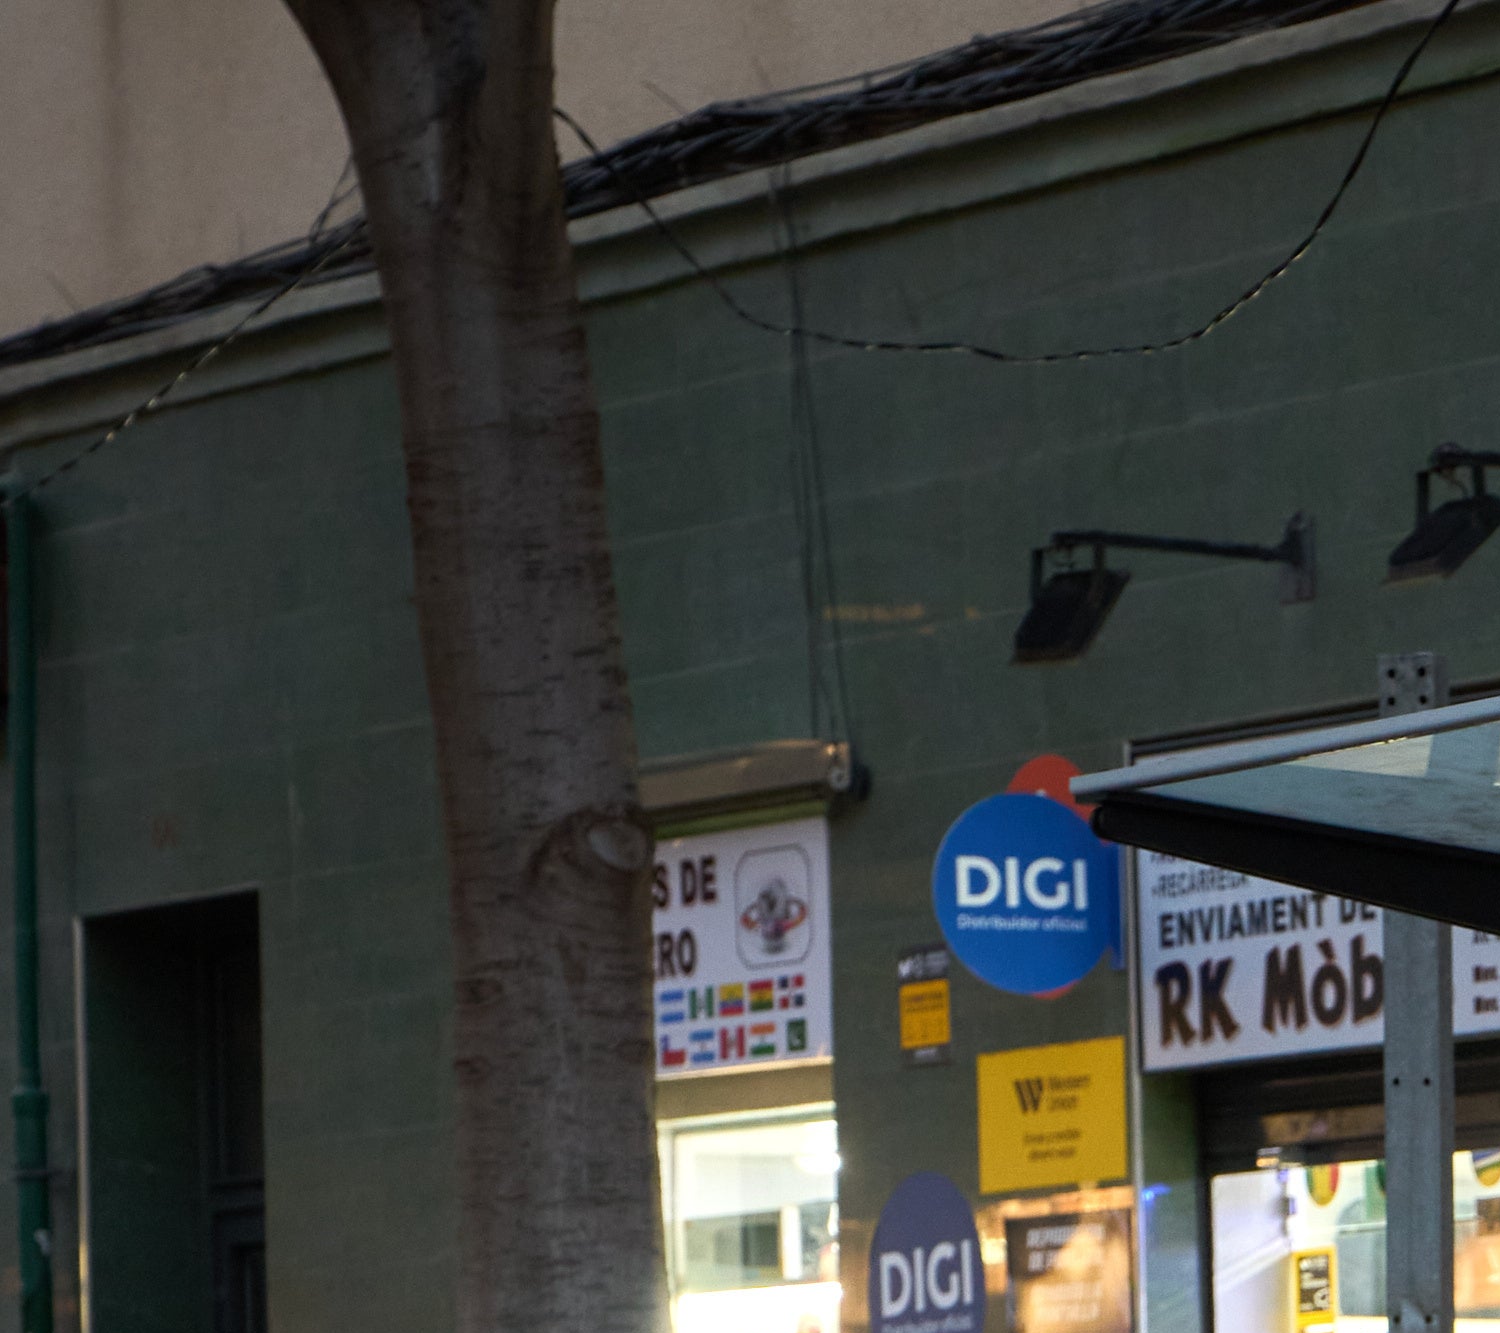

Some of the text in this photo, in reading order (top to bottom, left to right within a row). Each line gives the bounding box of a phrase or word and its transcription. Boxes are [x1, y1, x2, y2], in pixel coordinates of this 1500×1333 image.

[681, 855, 716, 905] DE
[955, 855, 1088, 910] DIGI
[1159, 893, 1327, 949] ENVIAMENT
[1156, 957, 1240, 1047] RK
[880, 1239, 974, 1318] DIGI
